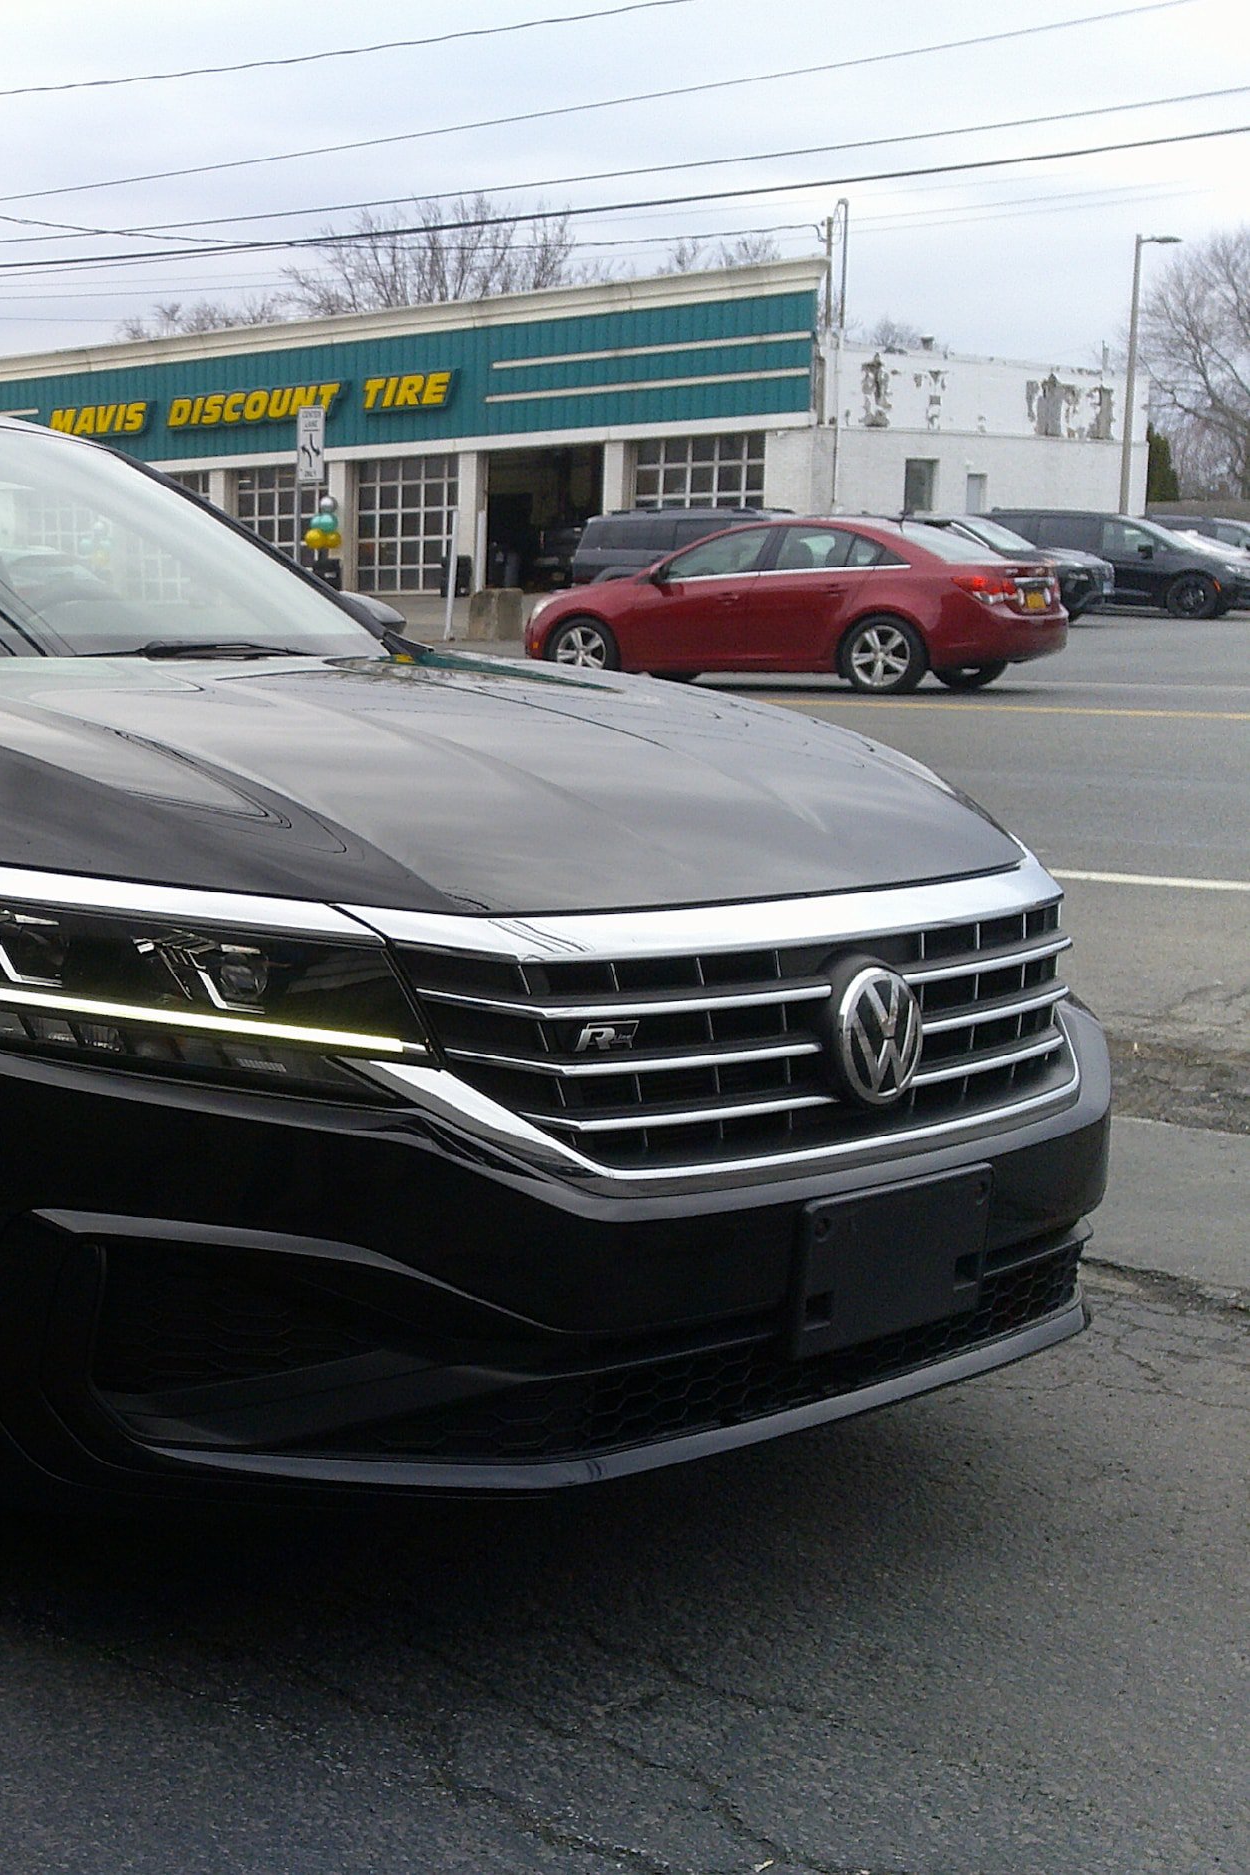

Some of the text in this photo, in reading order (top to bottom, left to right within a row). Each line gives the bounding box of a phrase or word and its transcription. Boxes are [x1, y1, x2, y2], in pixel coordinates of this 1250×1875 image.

[50, 372, 452, 436] MAVIS DISCOUNT TIRE
